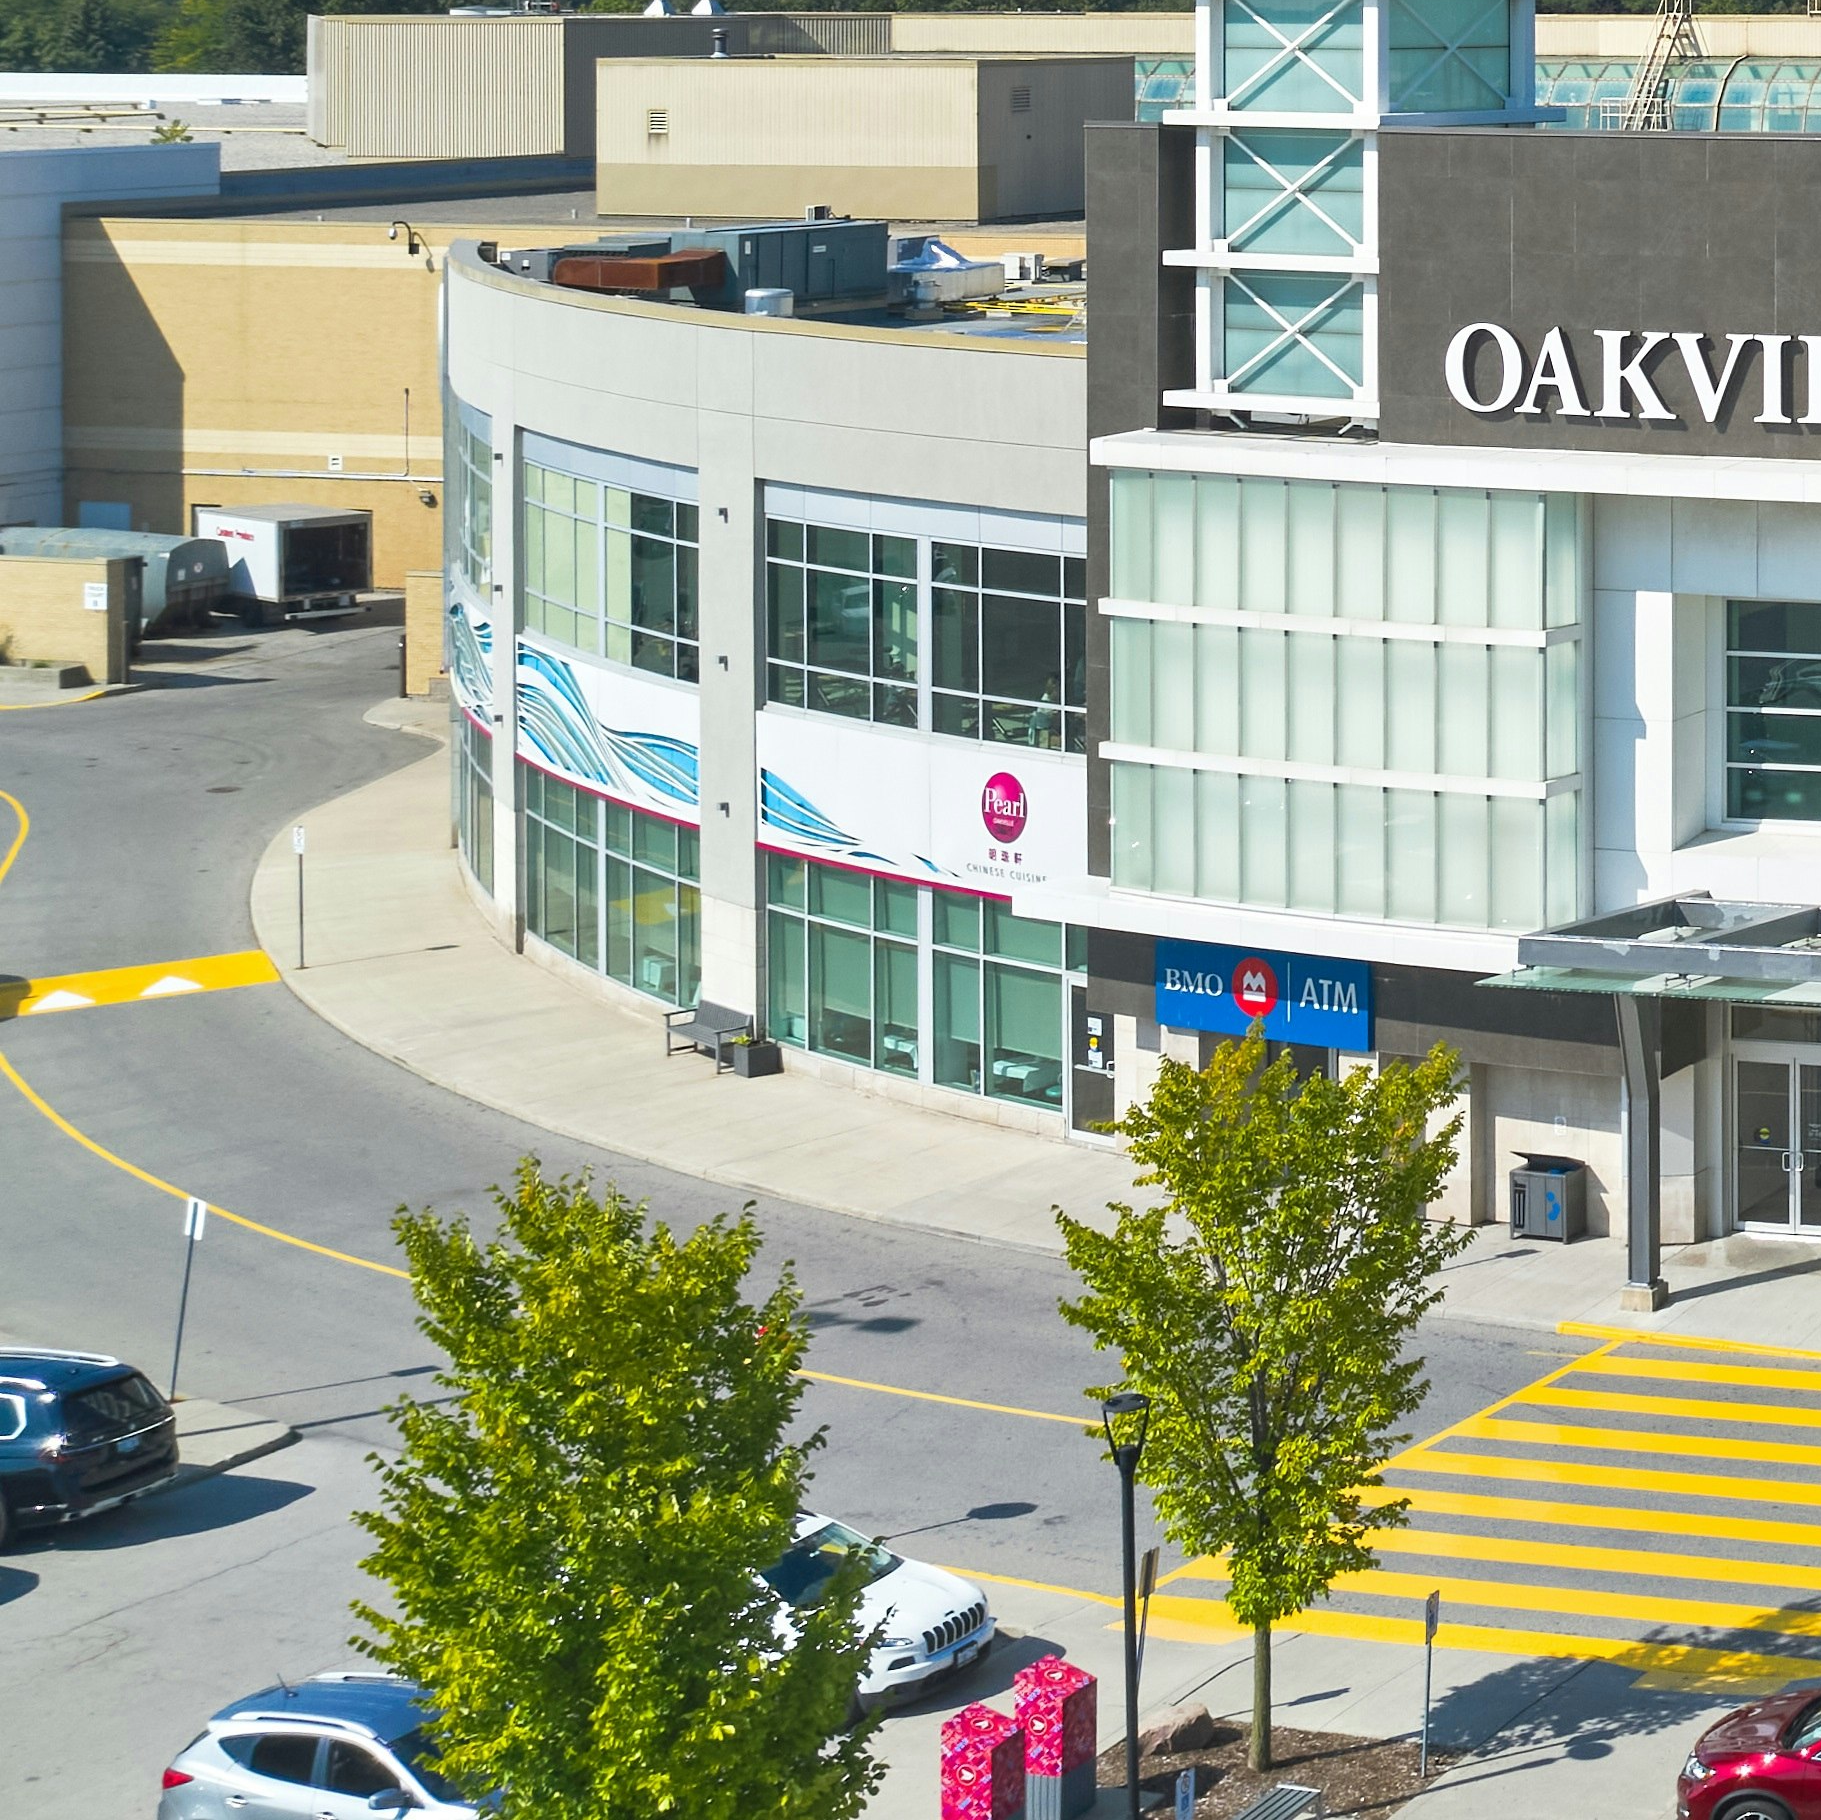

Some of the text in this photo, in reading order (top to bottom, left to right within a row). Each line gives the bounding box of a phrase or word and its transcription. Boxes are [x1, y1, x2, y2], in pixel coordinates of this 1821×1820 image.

[984, 787, 1025, 818] Pearl
[966, 862, 1006, 878] CHINESE
[1164, 968, 1359, 1014] BMO ATM
